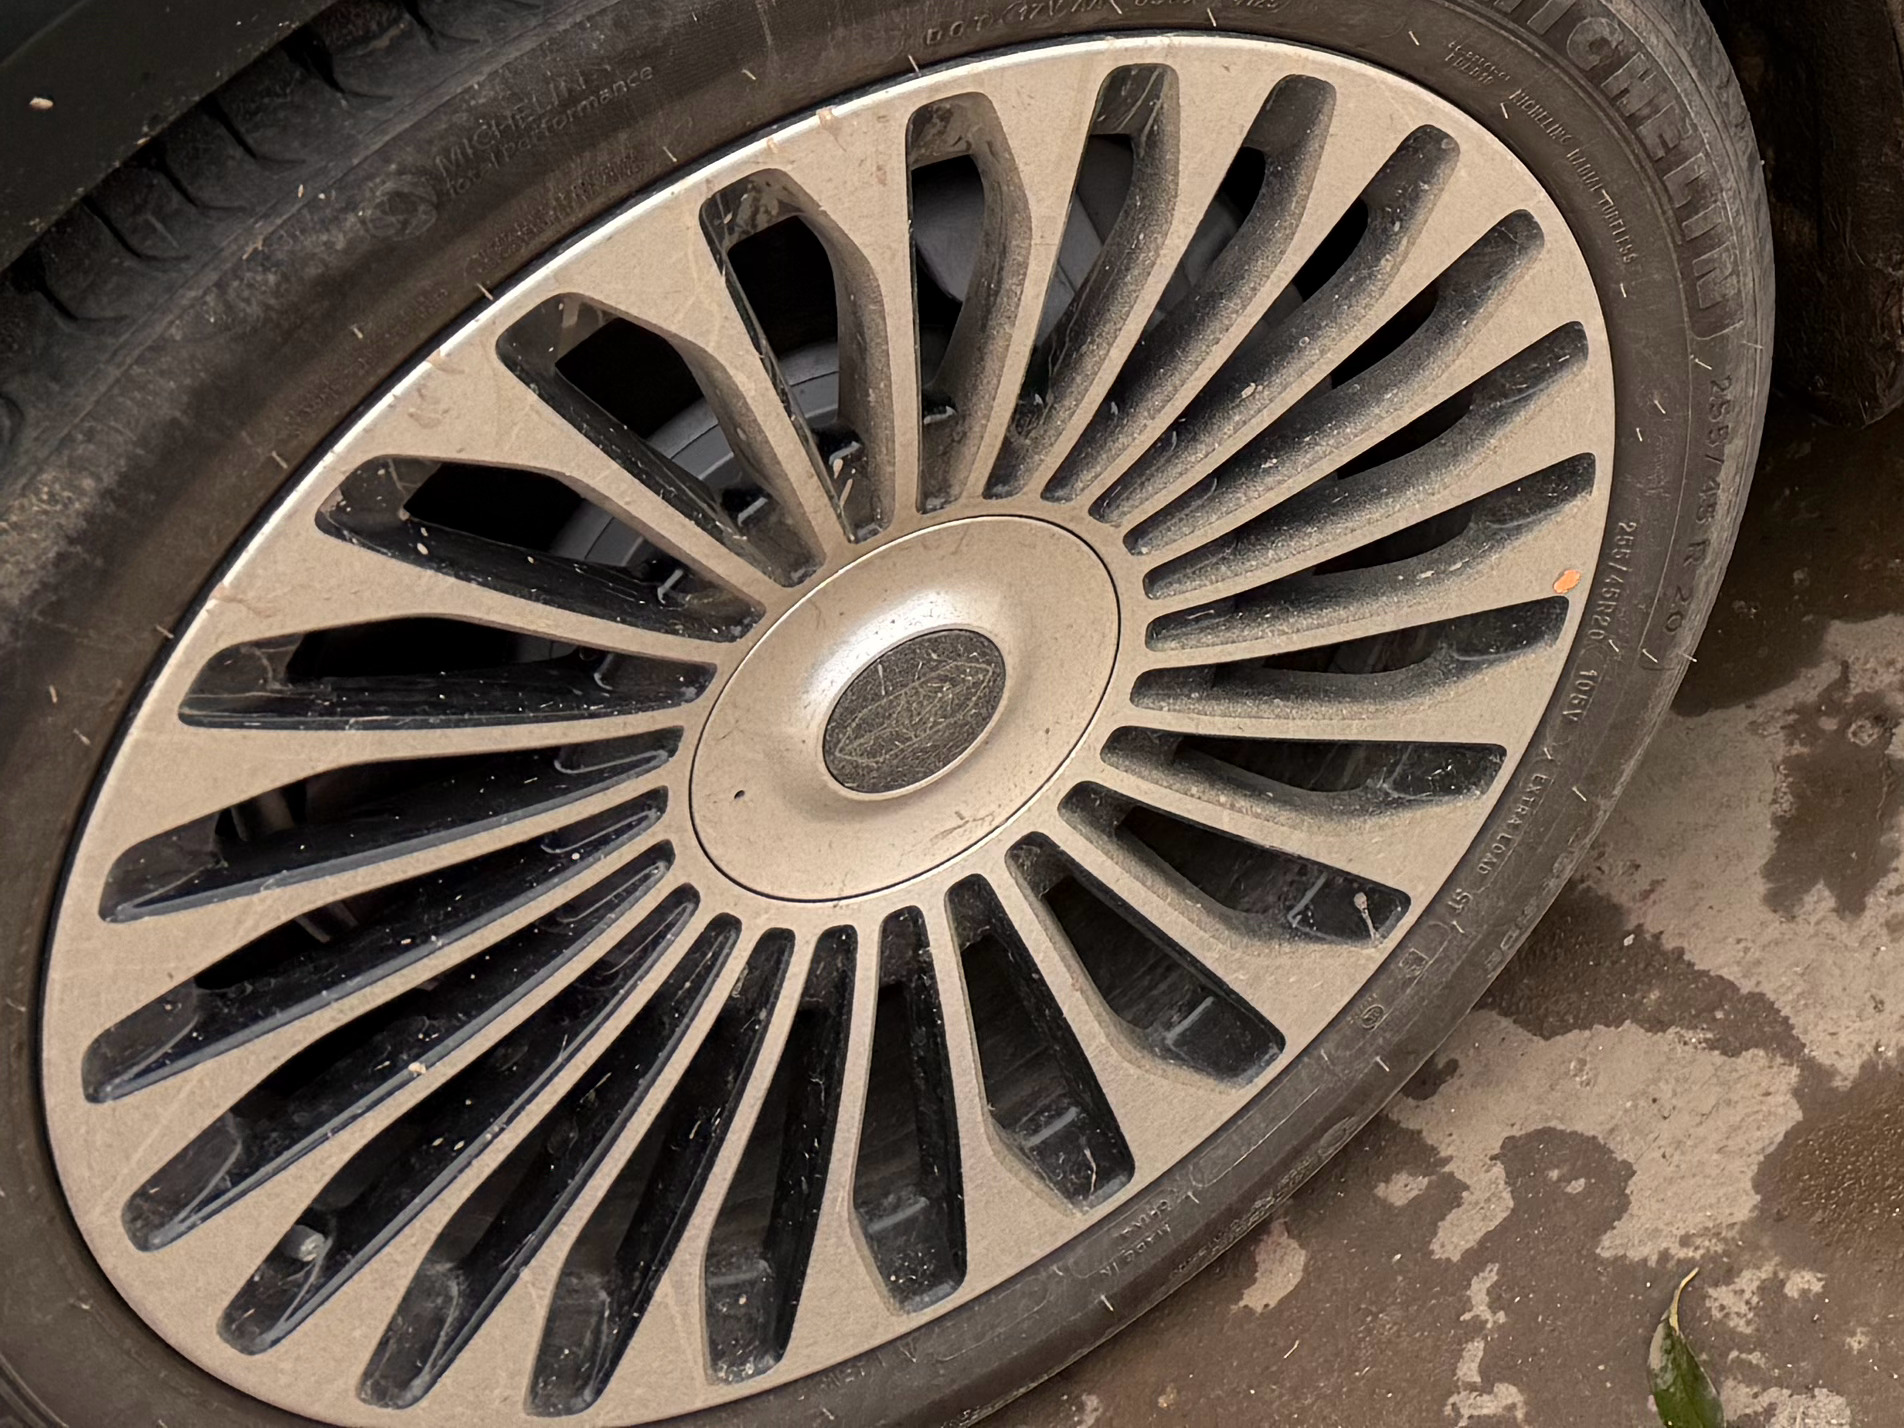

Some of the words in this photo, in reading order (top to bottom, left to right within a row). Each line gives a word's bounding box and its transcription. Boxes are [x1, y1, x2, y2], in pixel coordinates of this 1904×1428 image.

[1589, 521, 1637, 641] 255/45R20
[1664, 586, 1693, 634] 20
[1563, 669, 1599, 722] 105V
[1509, 773, 1553, 828] EXTRA
[1477, 833, 1515, 875] LOAD
